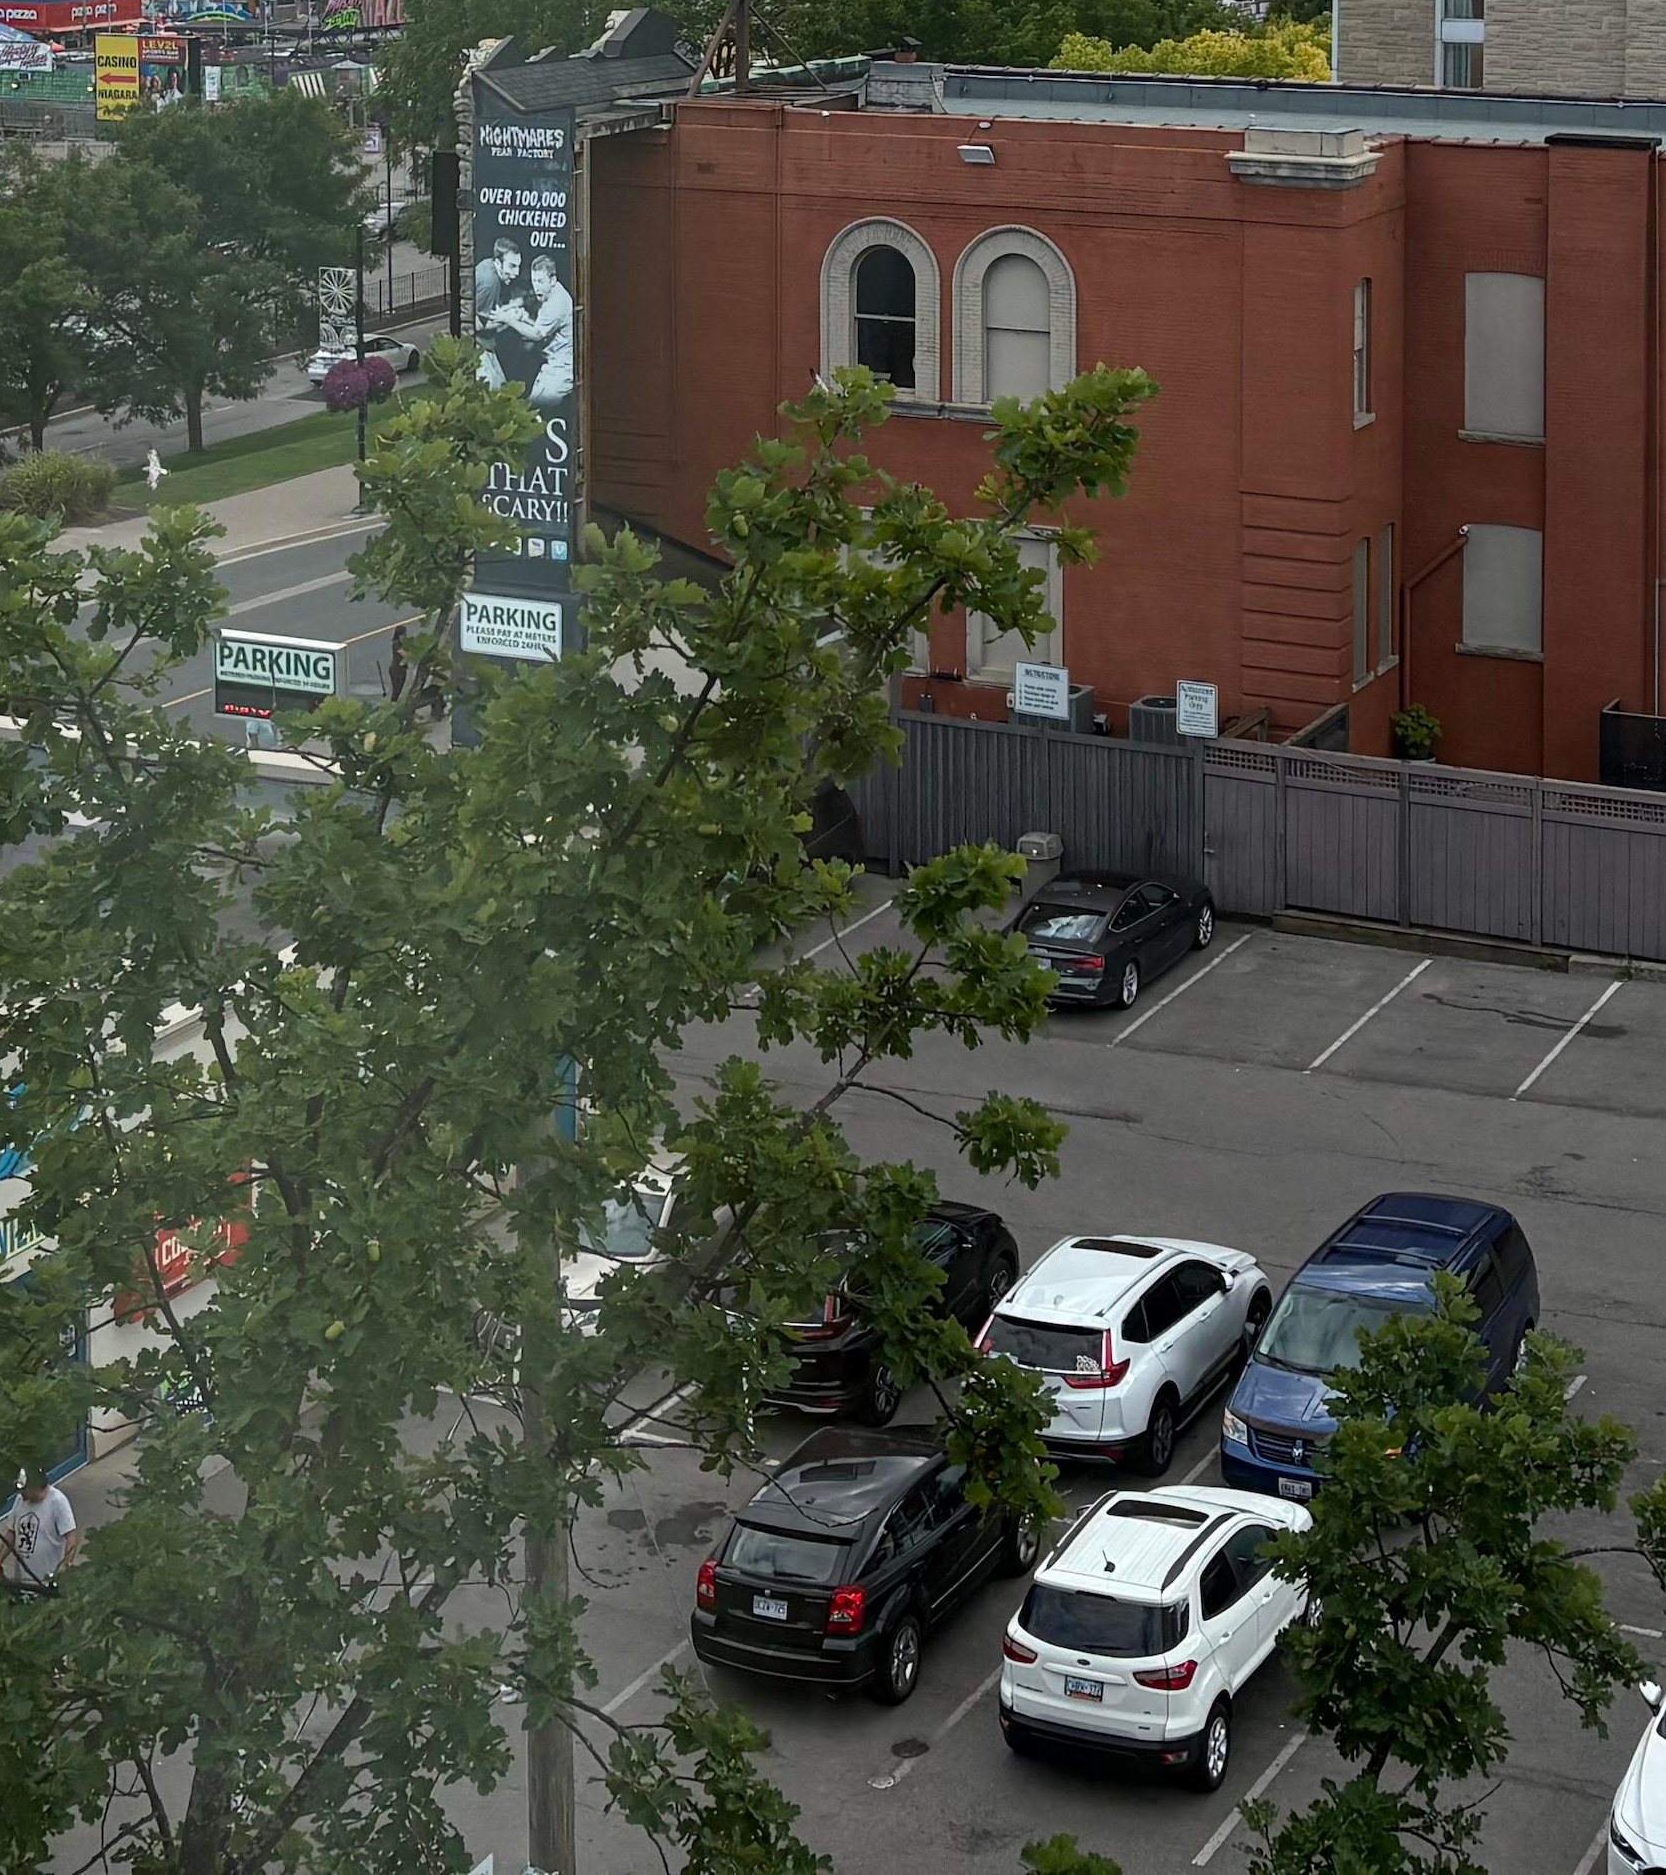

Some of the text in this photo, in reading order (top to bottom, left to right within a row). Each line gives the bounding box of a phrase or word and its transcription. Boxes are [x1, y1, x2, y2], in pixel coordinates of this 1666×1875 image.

[6, 7, 38, 21] pizza
[97, 55, 137, 69] CASINO
[97, 88, 139, 101] NIAGARA
[479, 124, 564, 149] NIGHTMARES
[491, 147, 554, 159] FEAR FACTORY
[479, 187, 567, 209] OVER 100,000
[497, 208, 567, 228] CHICKENED
[530, 230, 566, 249] OUT...
[486, 461, 568, 496] THAT
[466, 602, 557, 632] PARKING
[219, 644, 331, 681] PARKING
